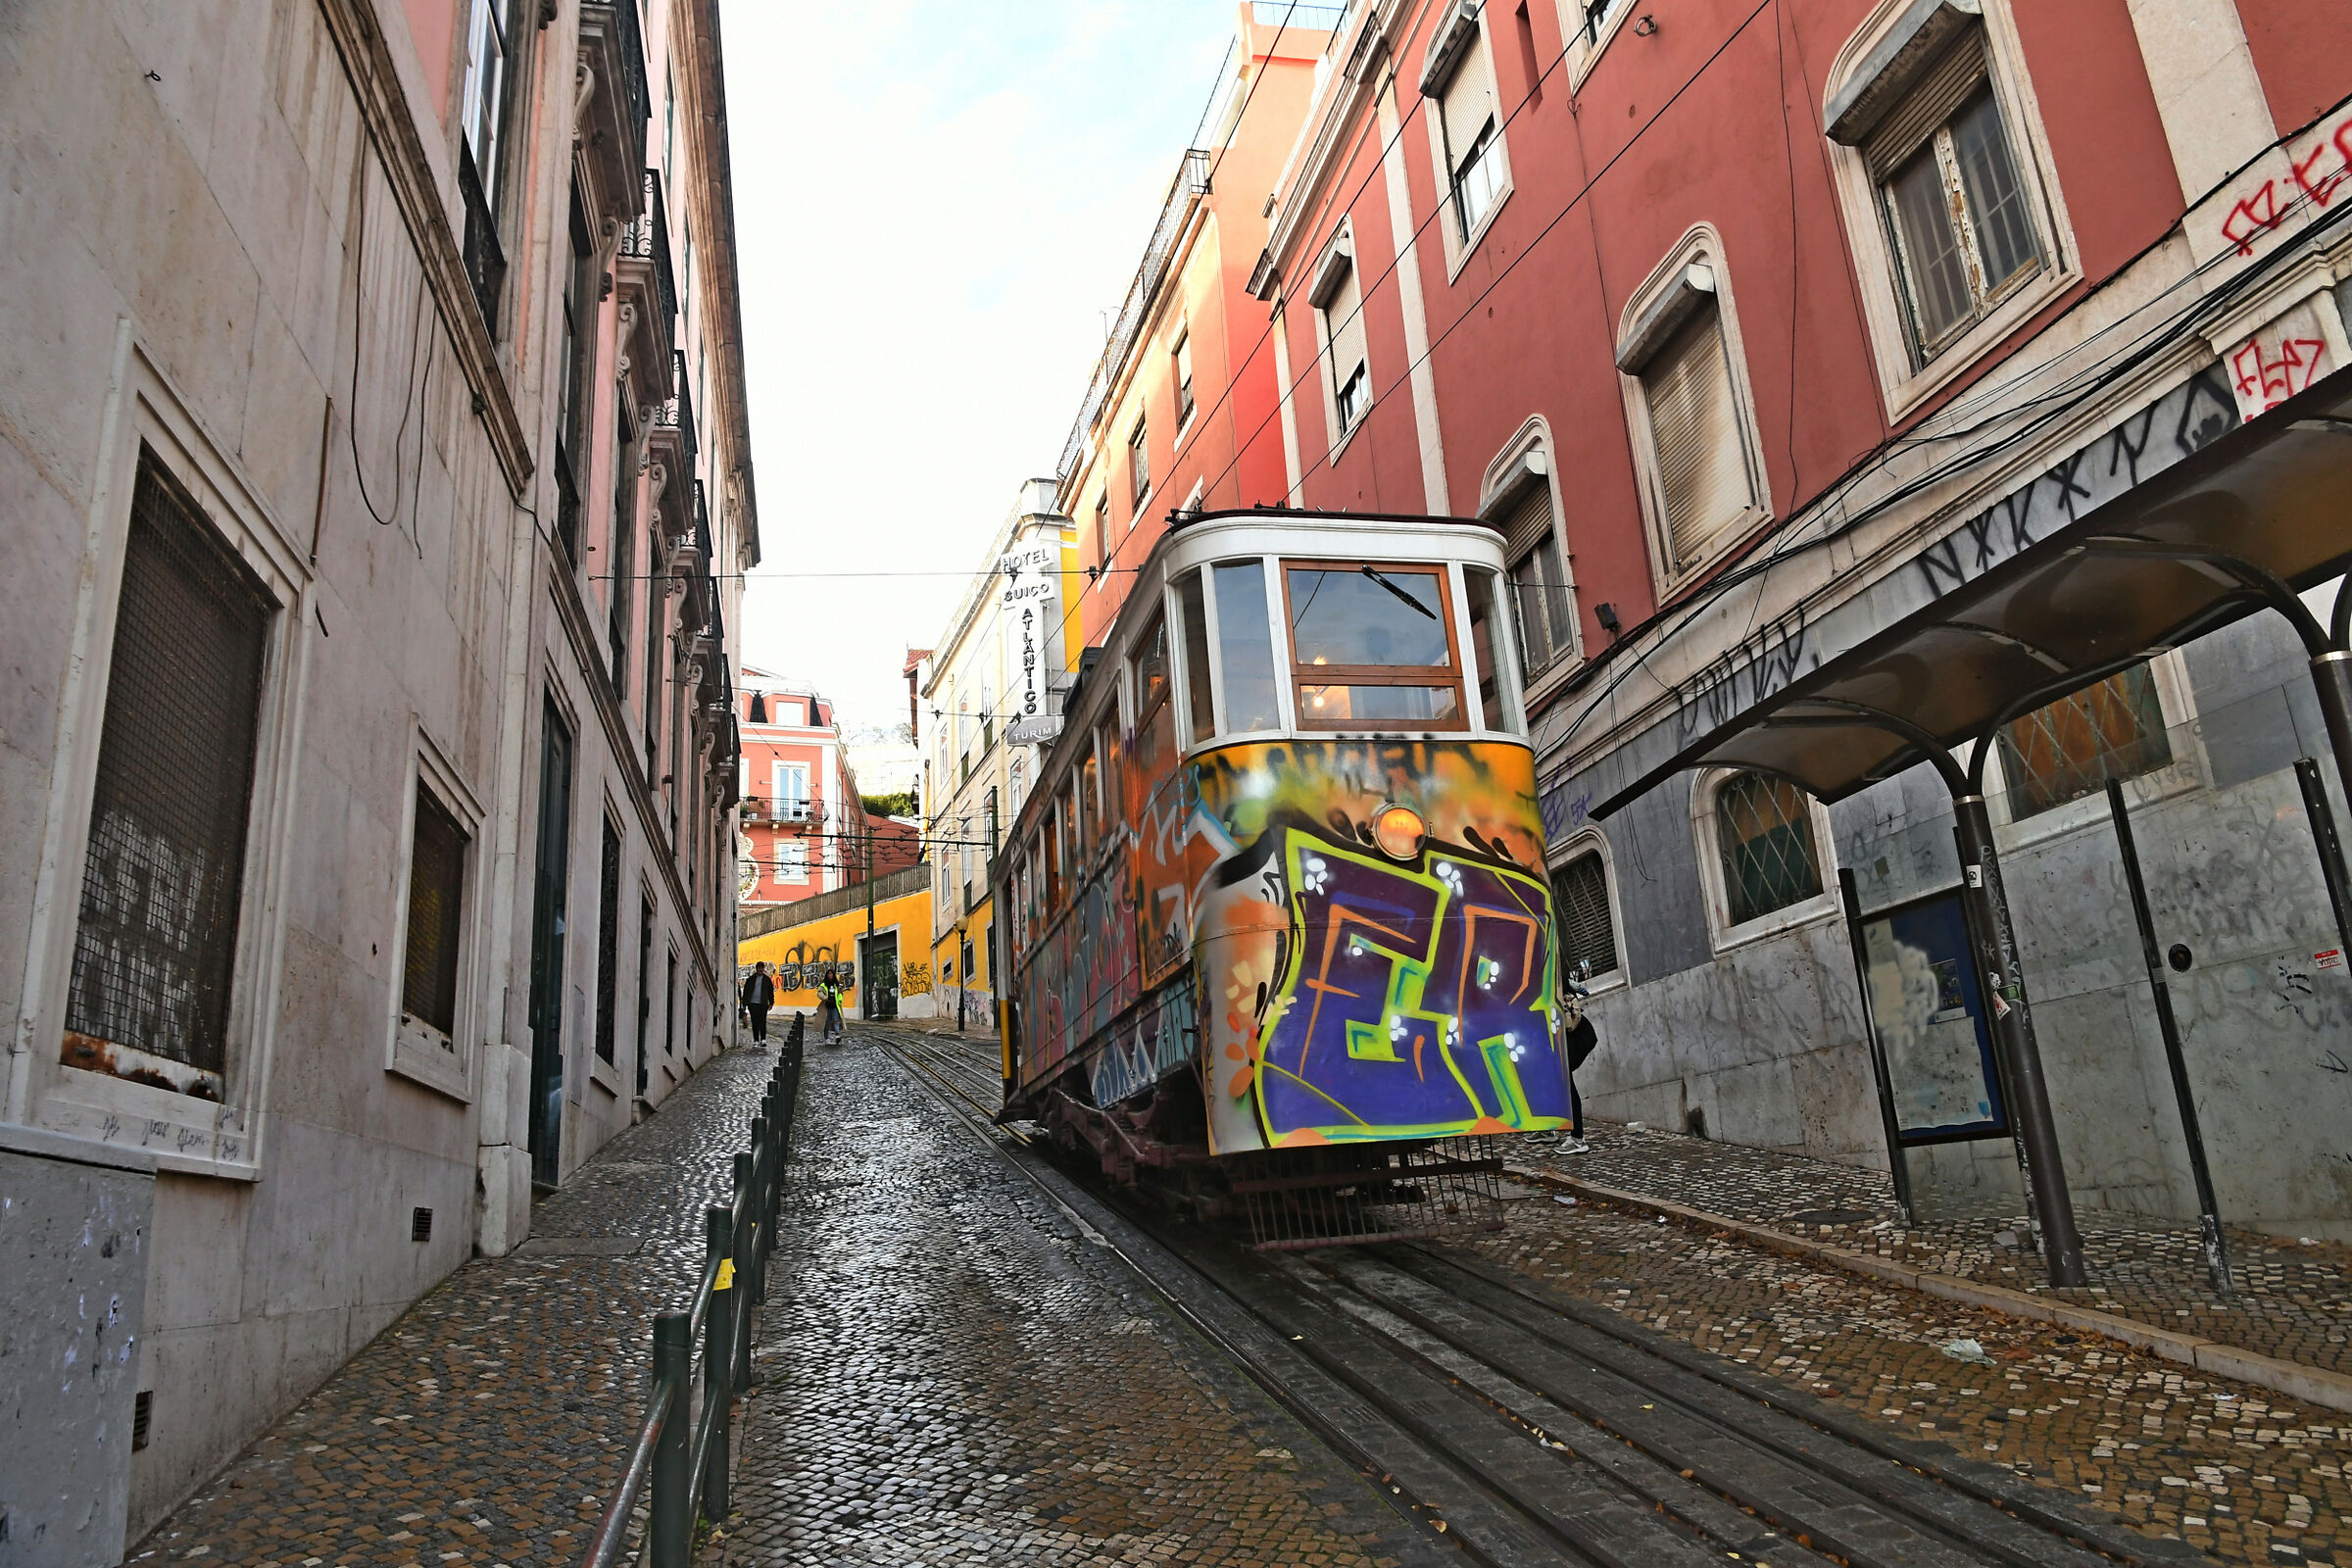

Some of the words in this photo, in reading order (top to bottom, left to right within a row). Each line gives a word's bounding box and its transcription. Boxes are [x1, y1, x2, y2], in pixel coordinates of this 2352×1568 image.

[1003, 548, 1050, 572] HOTEL
[1021, 608, 1038, 714] ATLANTICO
[1013, 726, 1052, 741] TURIM
